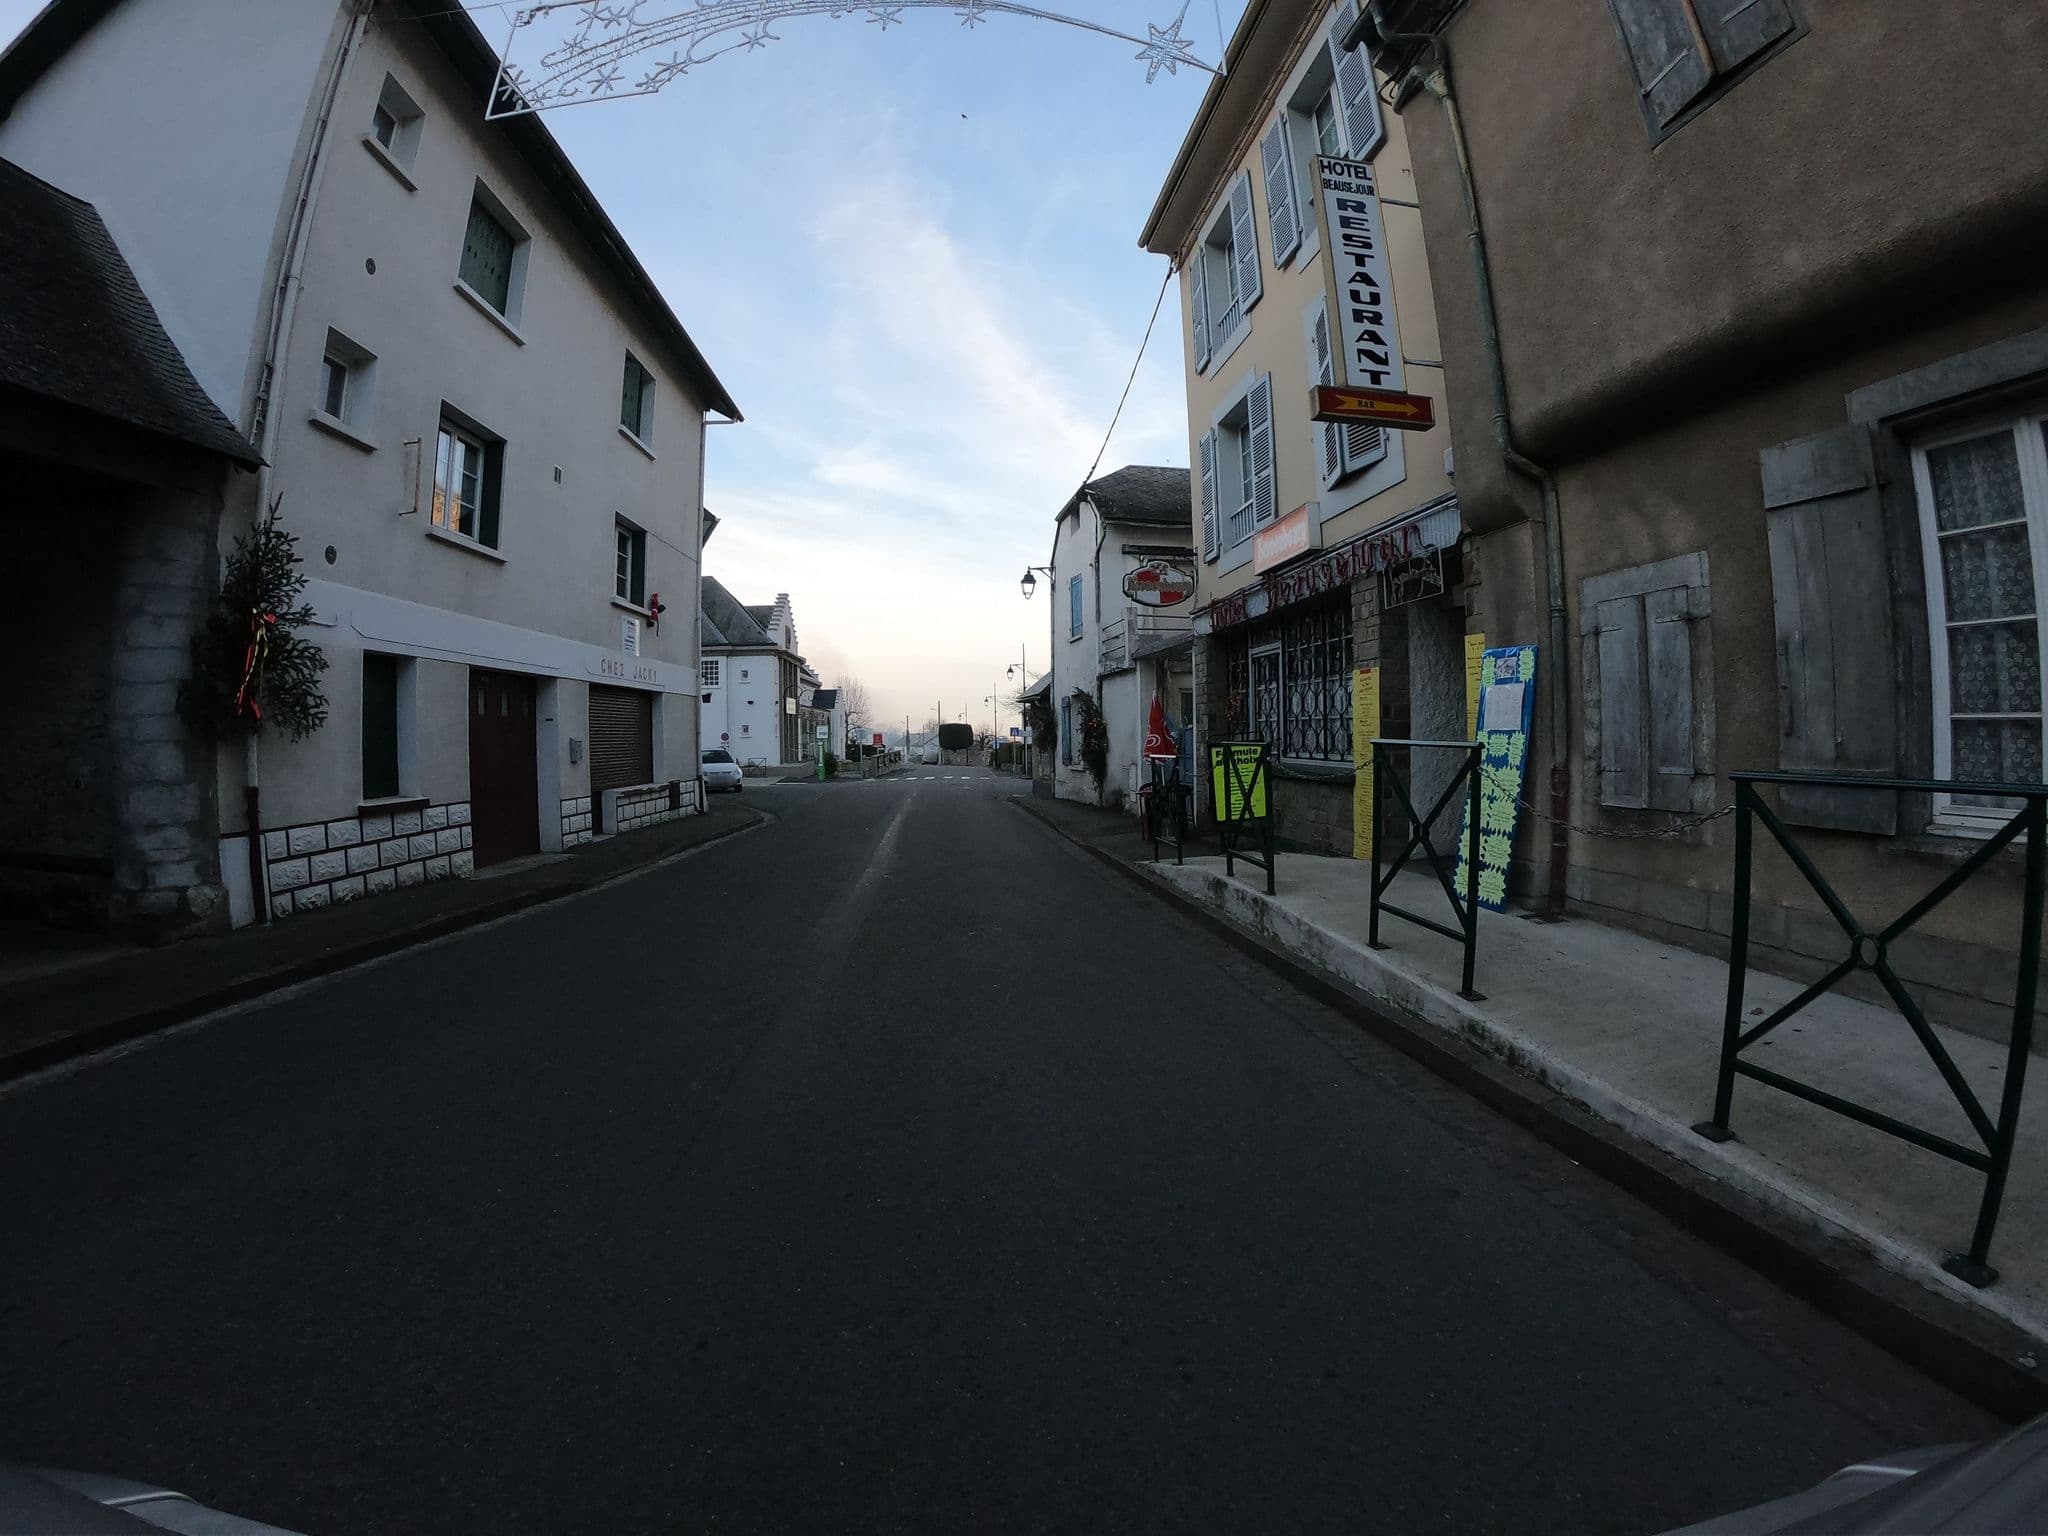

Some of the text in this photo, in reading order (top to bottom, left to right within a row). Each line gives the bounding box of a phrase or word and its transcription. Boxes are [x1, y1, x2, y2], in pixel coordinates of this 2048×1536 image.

[1320, 160, 1372, 181] HOTEL
[1323, 178, 1375, 196] BEAUSEJOUR
[1336, 197, 1391, 386] RESTAURANT
[1358, 399, 1376, 409] BAR
[601, 658, 625, 677] CHEZ
[1215, 747, 1258, 759] Fmule
